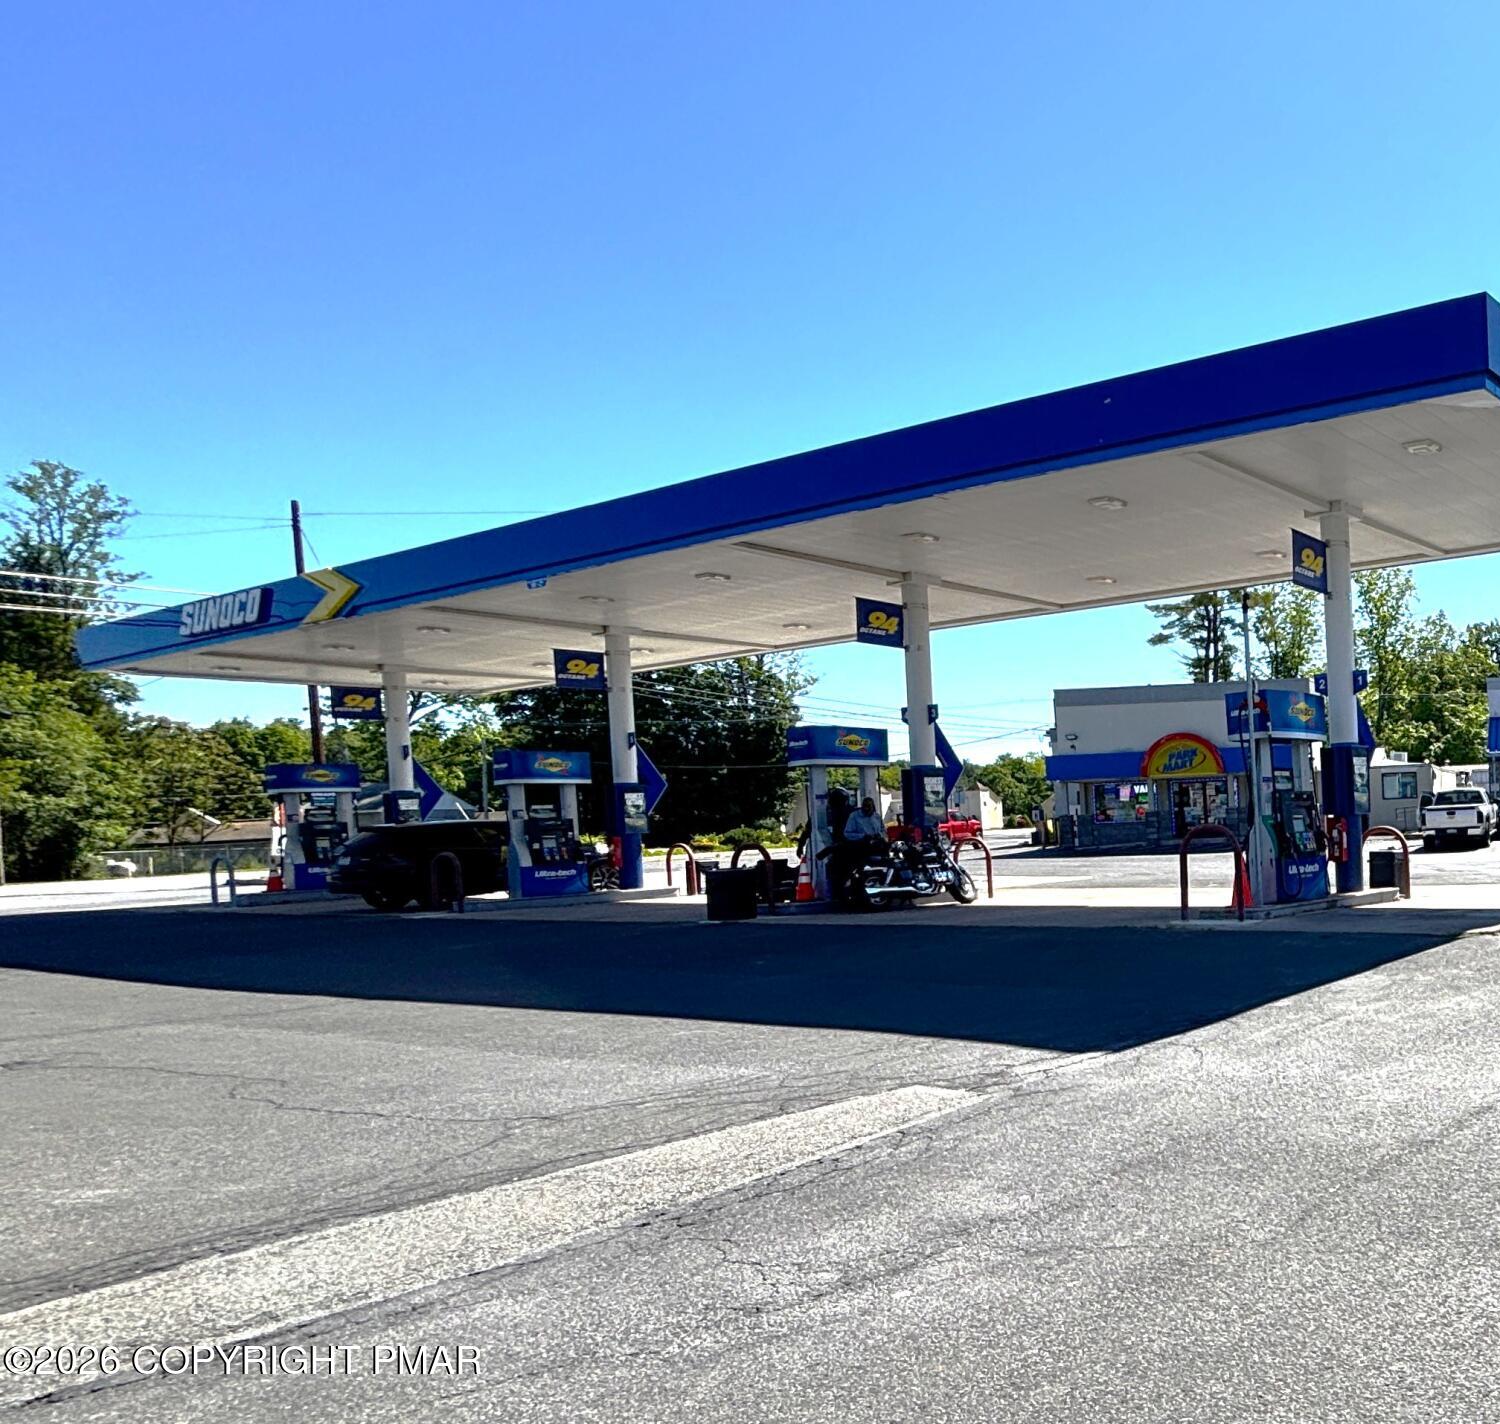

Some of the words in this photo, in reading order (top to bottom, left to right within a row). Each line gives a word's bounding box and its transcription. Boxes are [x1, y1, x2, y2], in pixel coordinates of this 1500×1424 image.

[1301, 548, 1324, 576] 94
[180, 588, 262, 636] SUNOCO
[868, 611, 900, 634] 94
[566, 659, 600, 678] 94
[1319, 679, 1326, 689] 2
[1357, 676, 1362, 685] 1
[343, 694, 376, 710] 94
